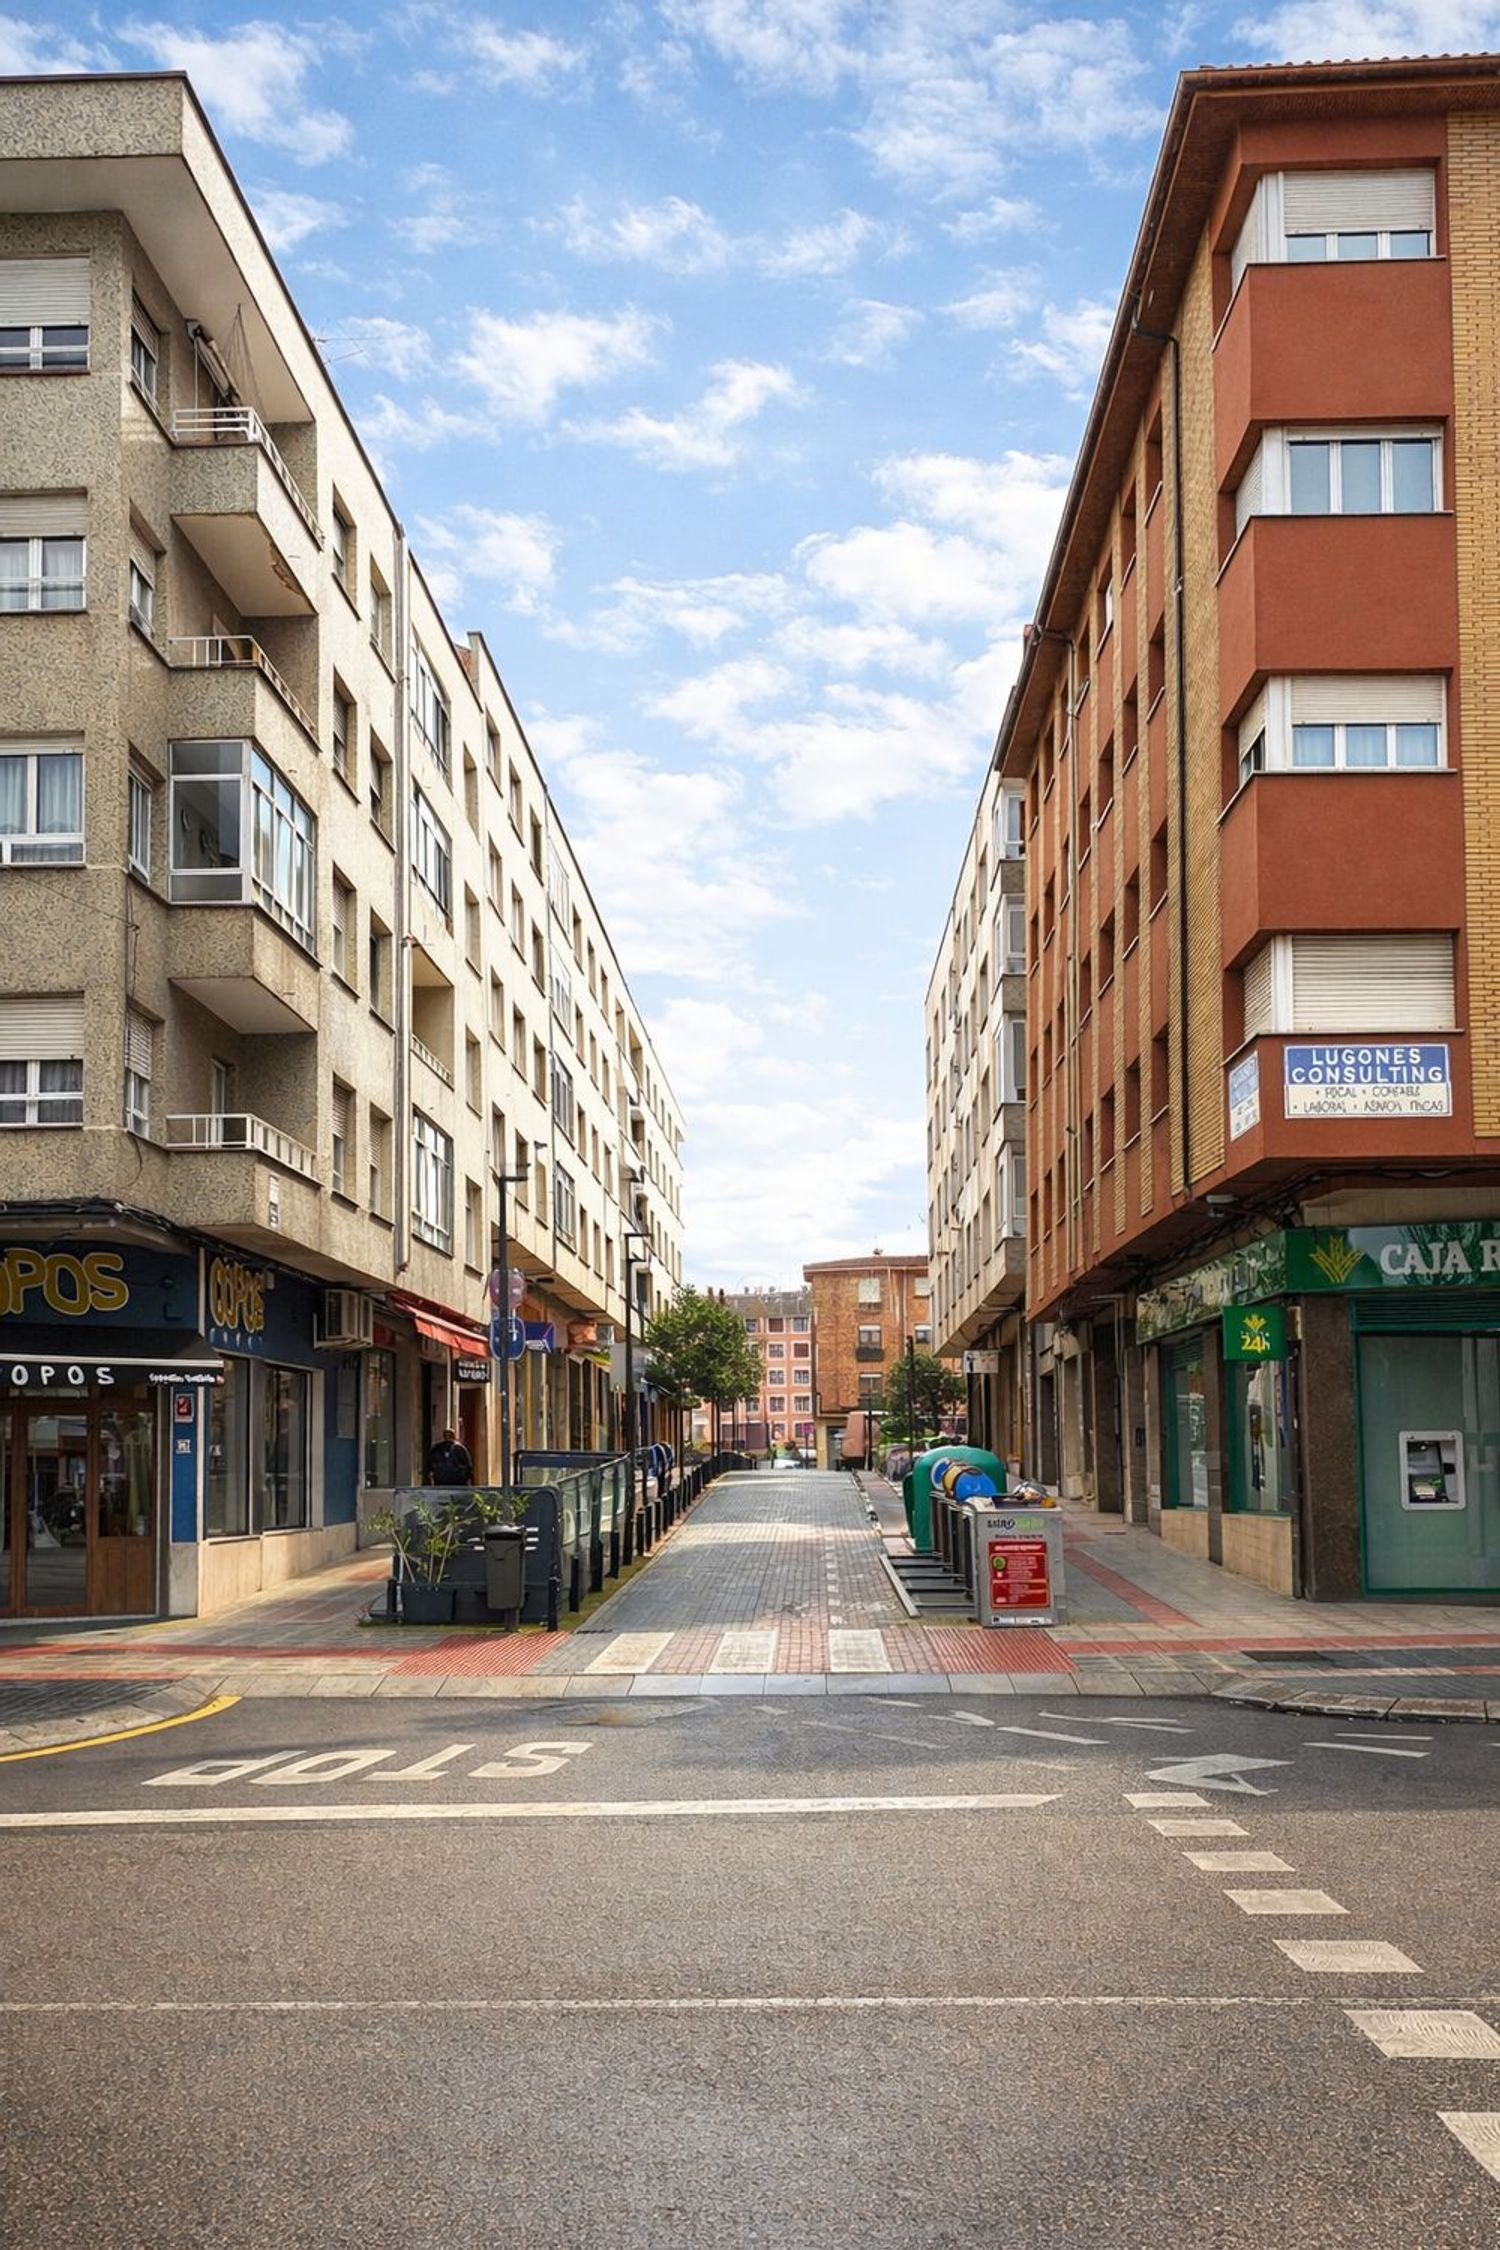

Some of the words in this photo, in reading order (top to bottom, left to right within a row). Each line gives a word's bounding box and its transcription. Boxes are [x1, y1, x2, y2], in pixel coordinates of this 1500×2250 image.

[1312, 1048, 1421, 1065] LUGONES
[1291, 1066, 1443, 1083] CONSULTING
[1380, 1240, 1472, 1275] CAJA
[0, 1247, 129, 1315] POS
[1241, 1331, 1270, 1354] 24h
[140, 1741, 595, 1786] STOP
